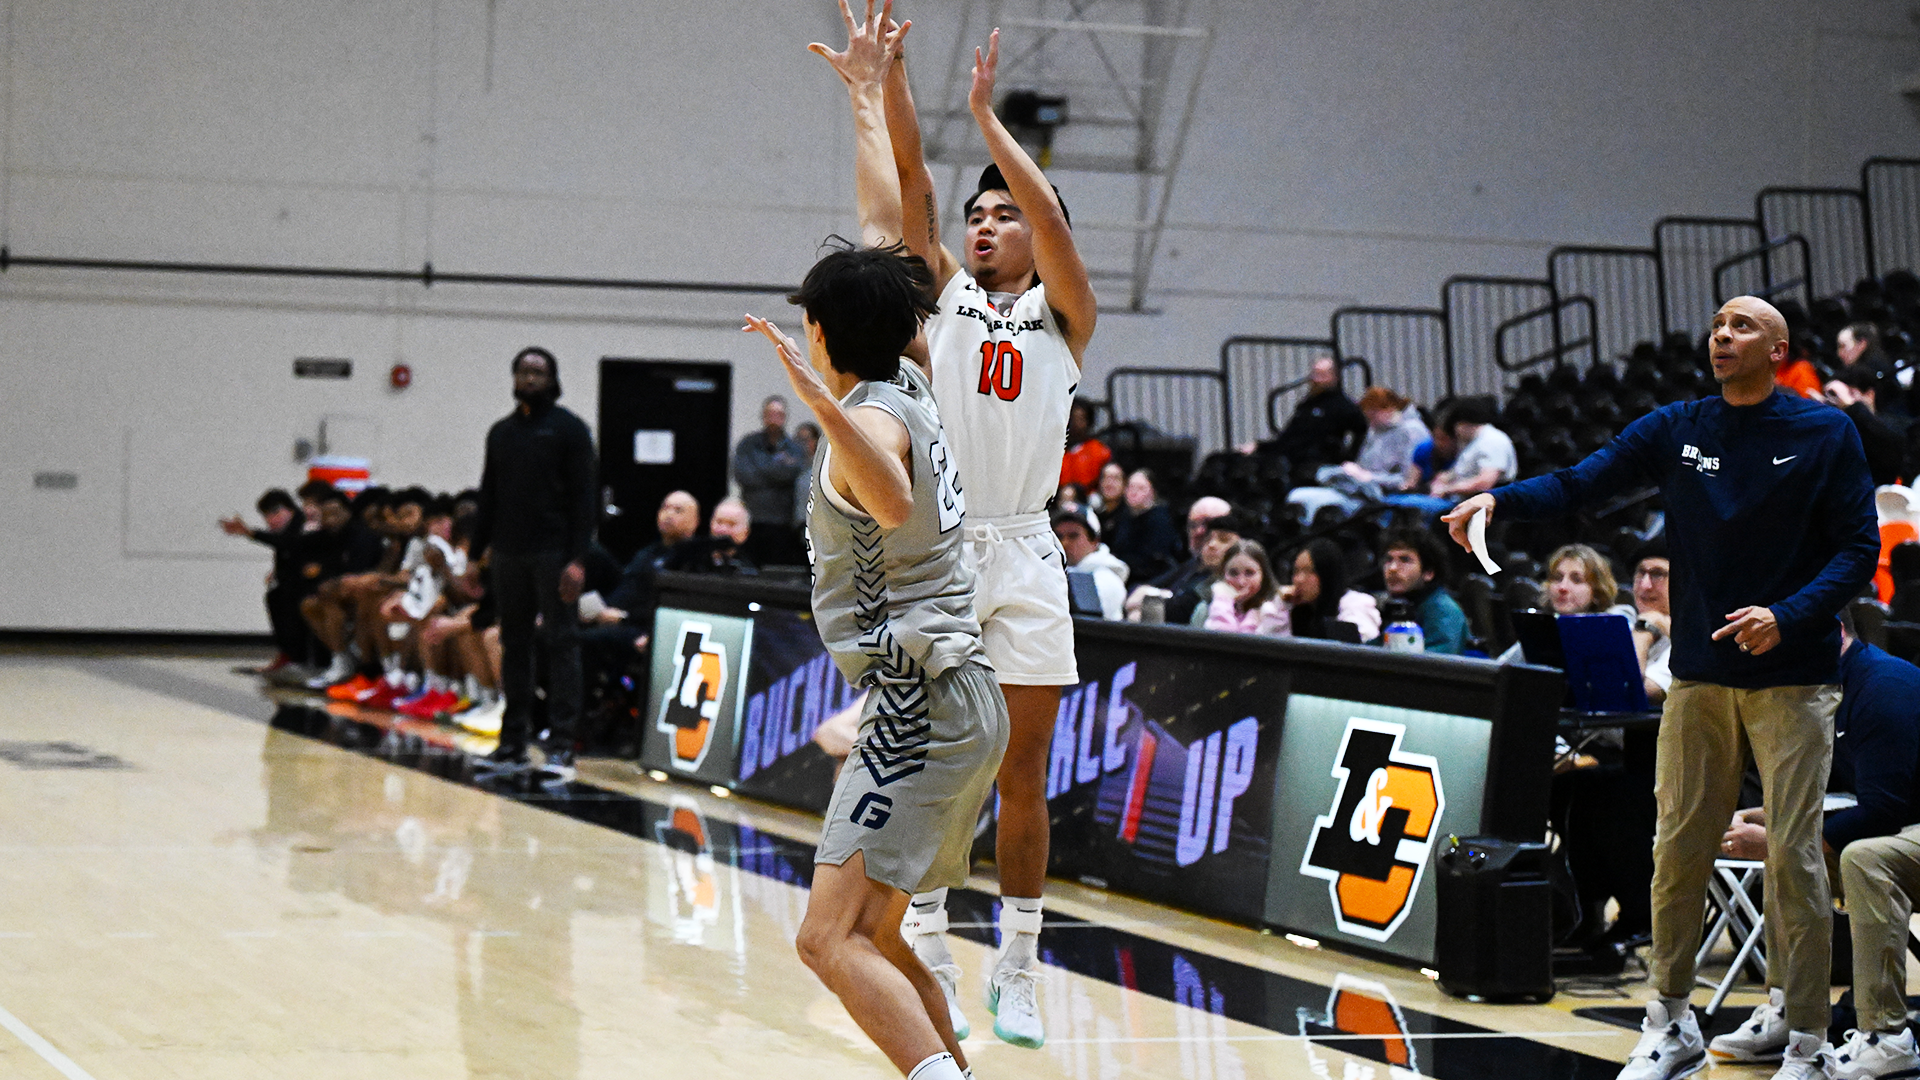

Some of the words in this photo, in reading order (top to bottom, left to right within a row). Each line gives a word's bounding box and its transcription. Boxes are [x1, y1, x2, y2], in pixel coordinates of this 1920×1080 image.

[993, 320, 1004, 330] &
[1005, 319, 1045, 336] CARK
[977, 340, 1023, 402] 10
[1176, 716, 1259, 868] UP
